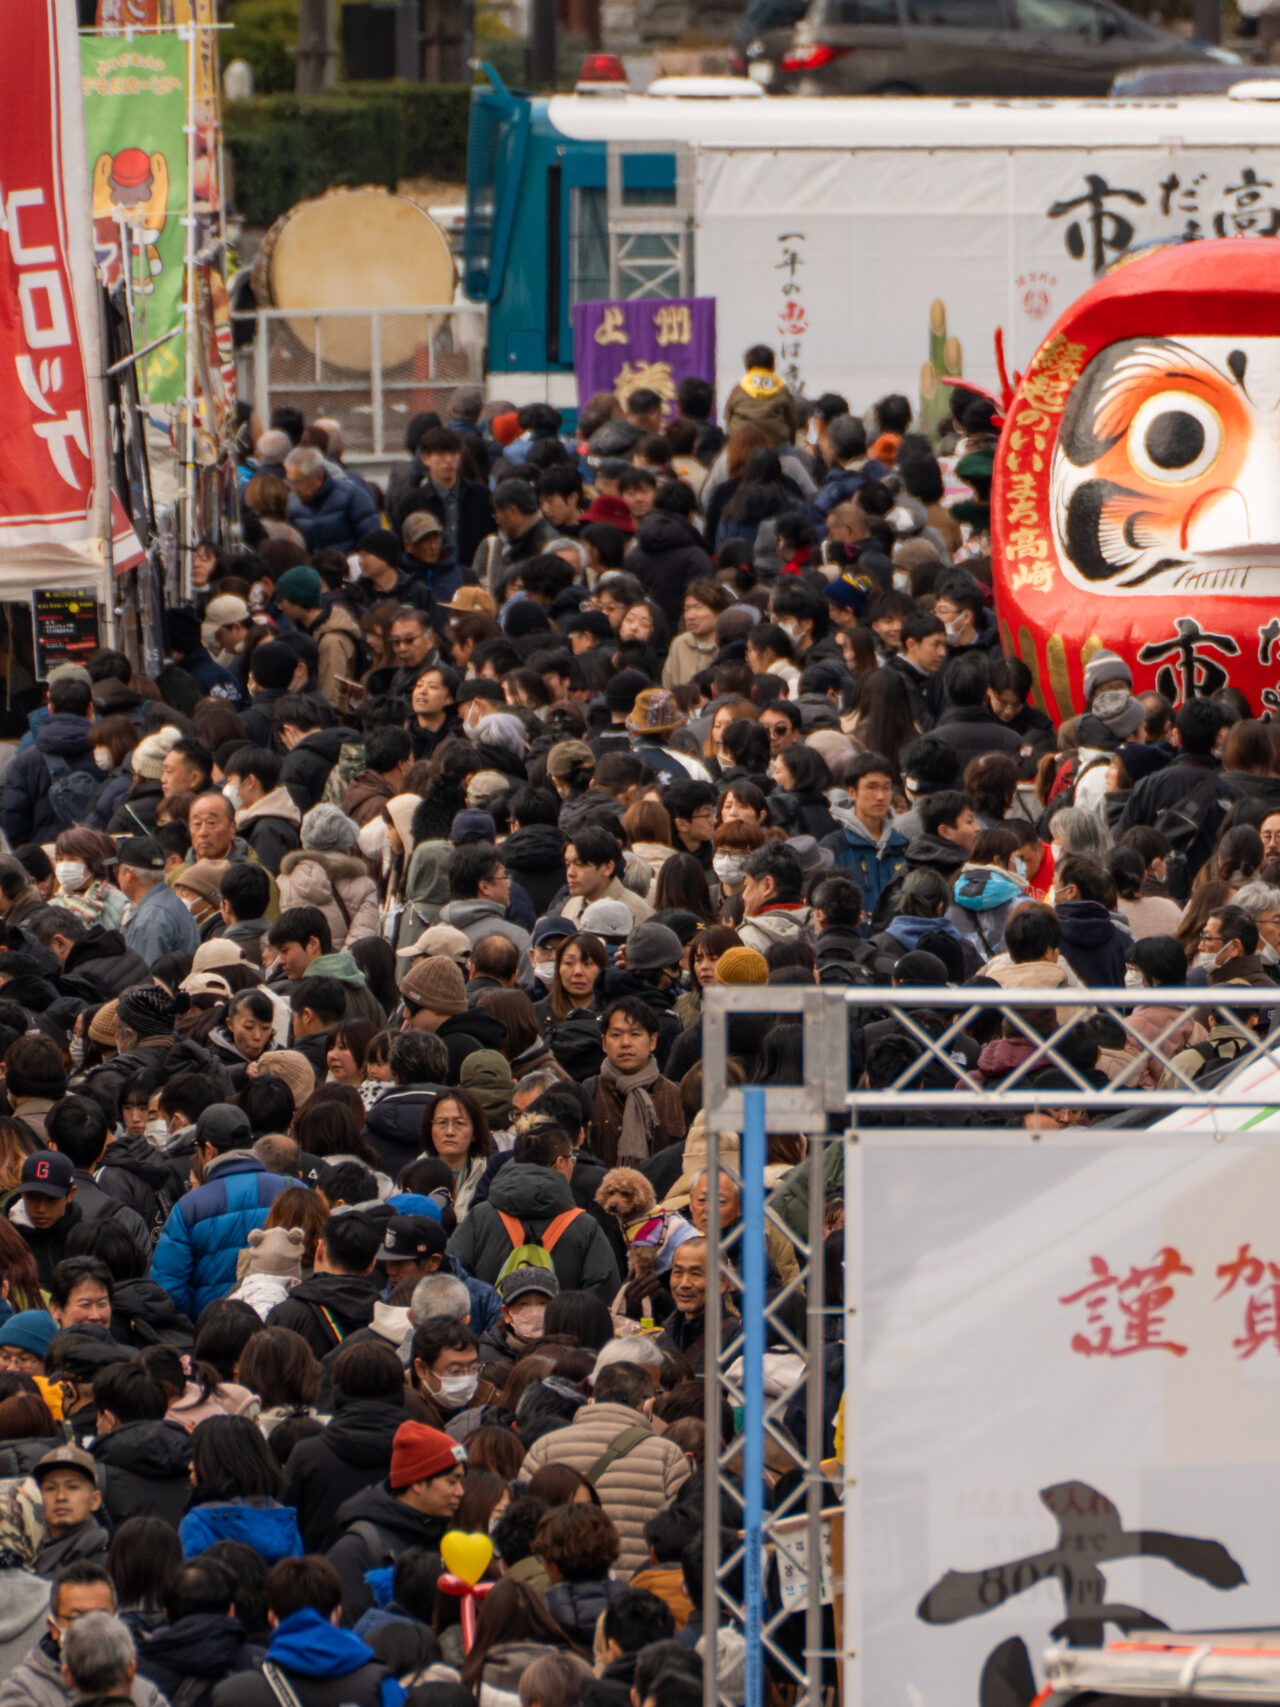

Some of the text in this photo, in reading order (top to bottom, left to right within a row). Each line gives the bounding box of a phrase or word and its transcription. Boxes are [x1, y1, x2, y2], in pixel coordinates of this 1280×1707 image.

[1046, 173, 1147, 280] 市
[1006, 334, 1088, 594] 縁起のいいまち高崎
[1137, 616, 1242, 708] 市
[785, 1586, 796, 1597] 21
